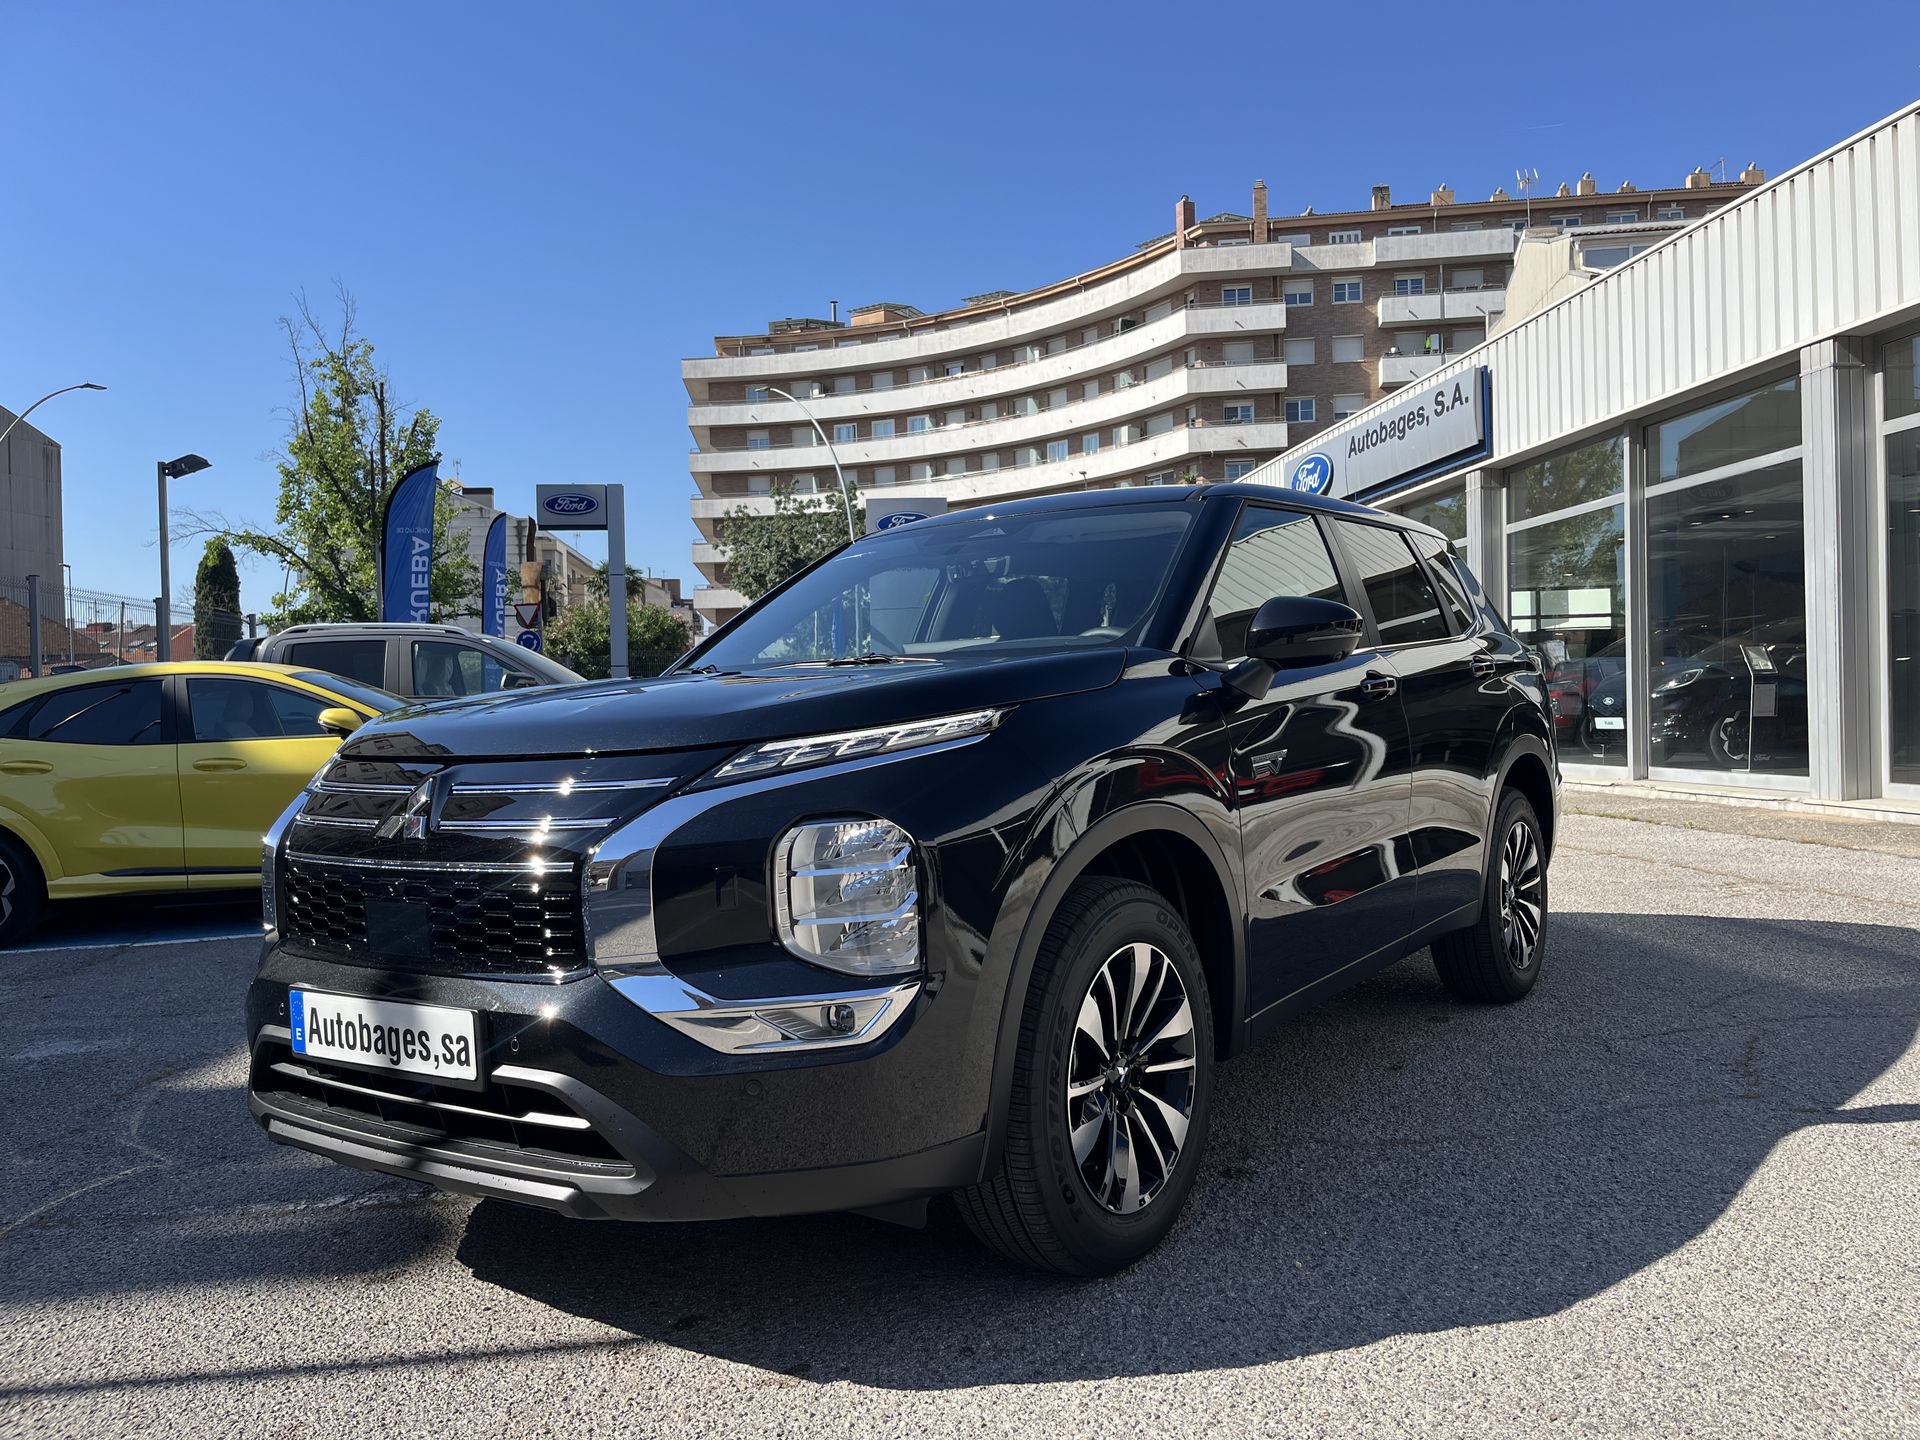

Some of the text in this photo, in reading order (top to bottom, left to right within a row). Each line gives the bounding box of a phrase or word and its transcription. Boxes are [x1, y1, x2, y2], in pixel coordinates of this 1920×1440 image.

[1348, 382, 1469, 459] Autobages, S.A.
[1296, 461, 1320, 492] Ford
[554, 497, 587, 510] Ford
[295, 1027, 303, 1041] E
[308, 1007, 471, 1069] Autobages,sa
[1048, 1005, 1068, 1128] TIRES
